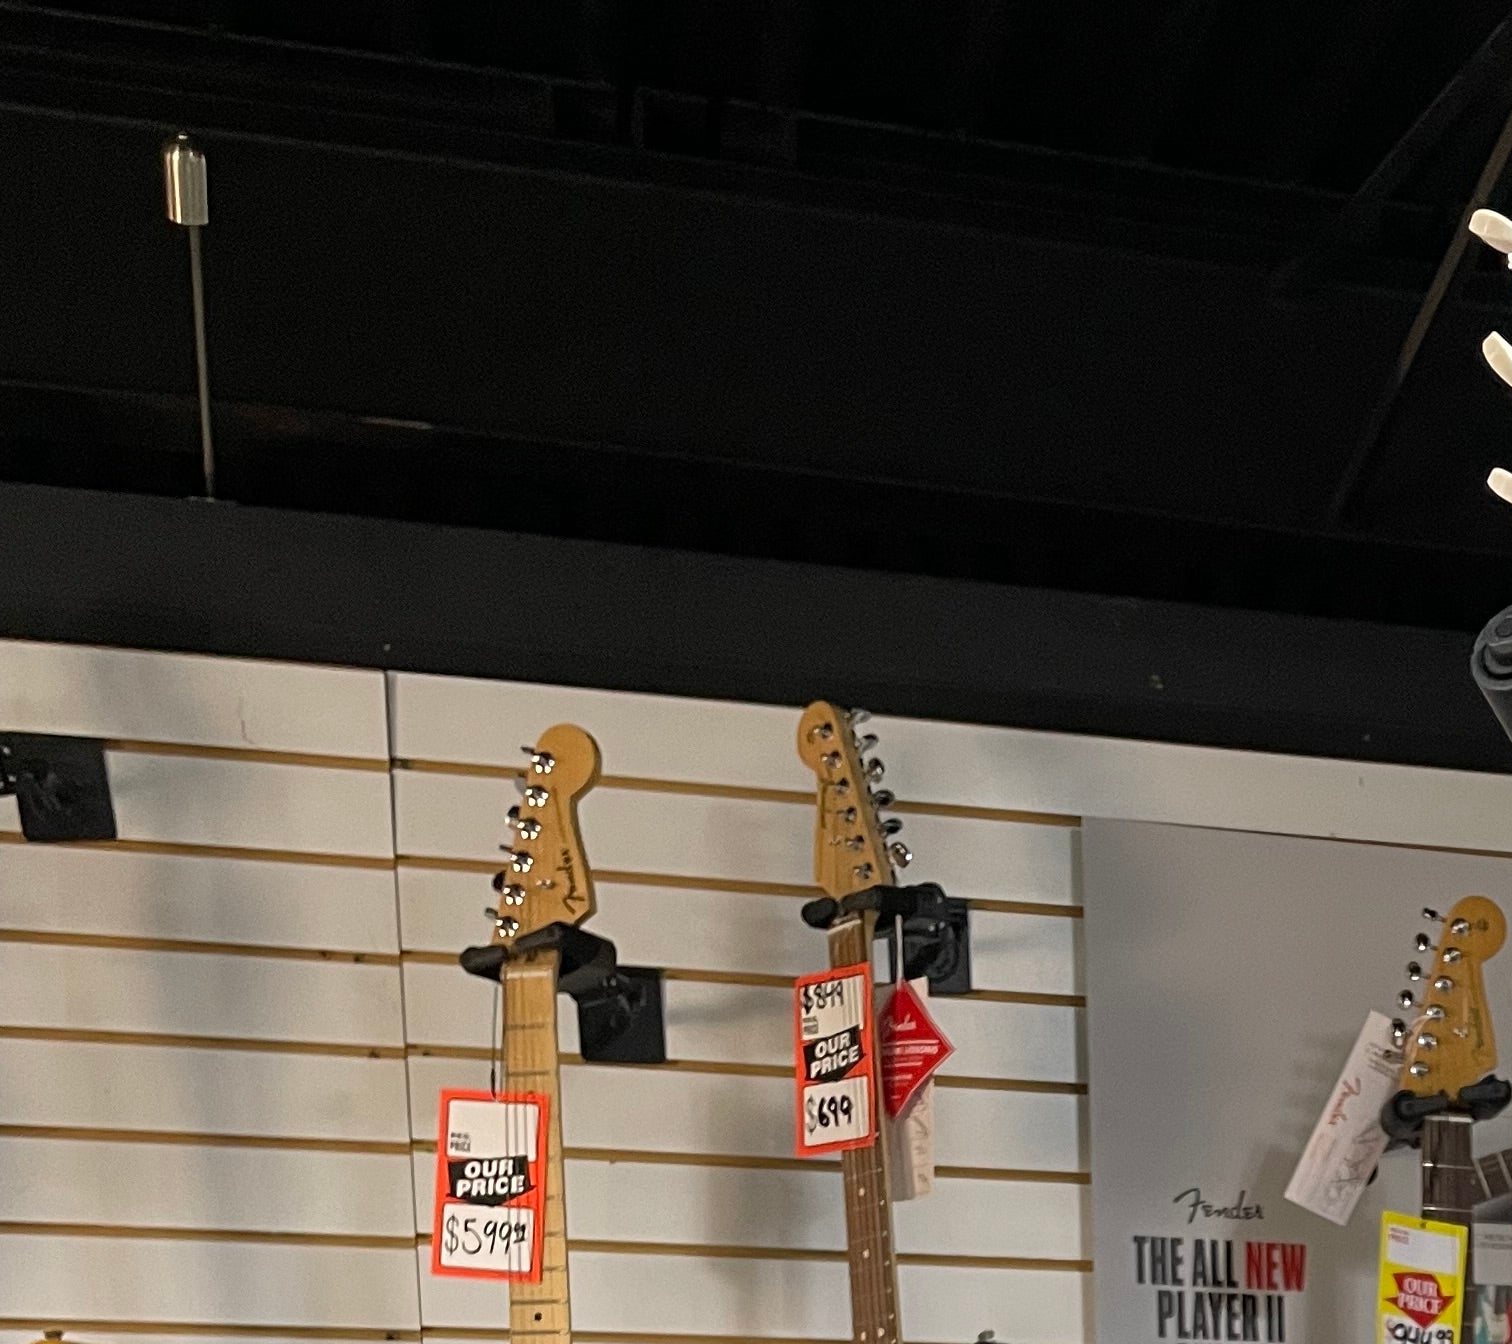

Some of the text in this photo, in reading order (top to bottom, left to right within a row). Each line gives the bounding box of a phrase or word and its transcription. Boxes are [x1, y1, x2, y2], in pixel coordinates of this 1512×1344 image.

[815, 1032, 852, 1058] OUR
[810, 1046, 860, 1080] PRICE
[806, 1095, 853, 1135] $699
[464, 1159, 514, 1178] OUR
[456, 1175, 526, 1198] PRICE
[1173, 1187, 1265, 1224] Fender
[1133, 1235, 1308, 1293] THE ALL NEW
[1402, 1277, 1438, 1298] OUR
[1157, 1290, 1287, 1343] PLAYER II
[1397, 1292, 1444, 1315] PRICE
